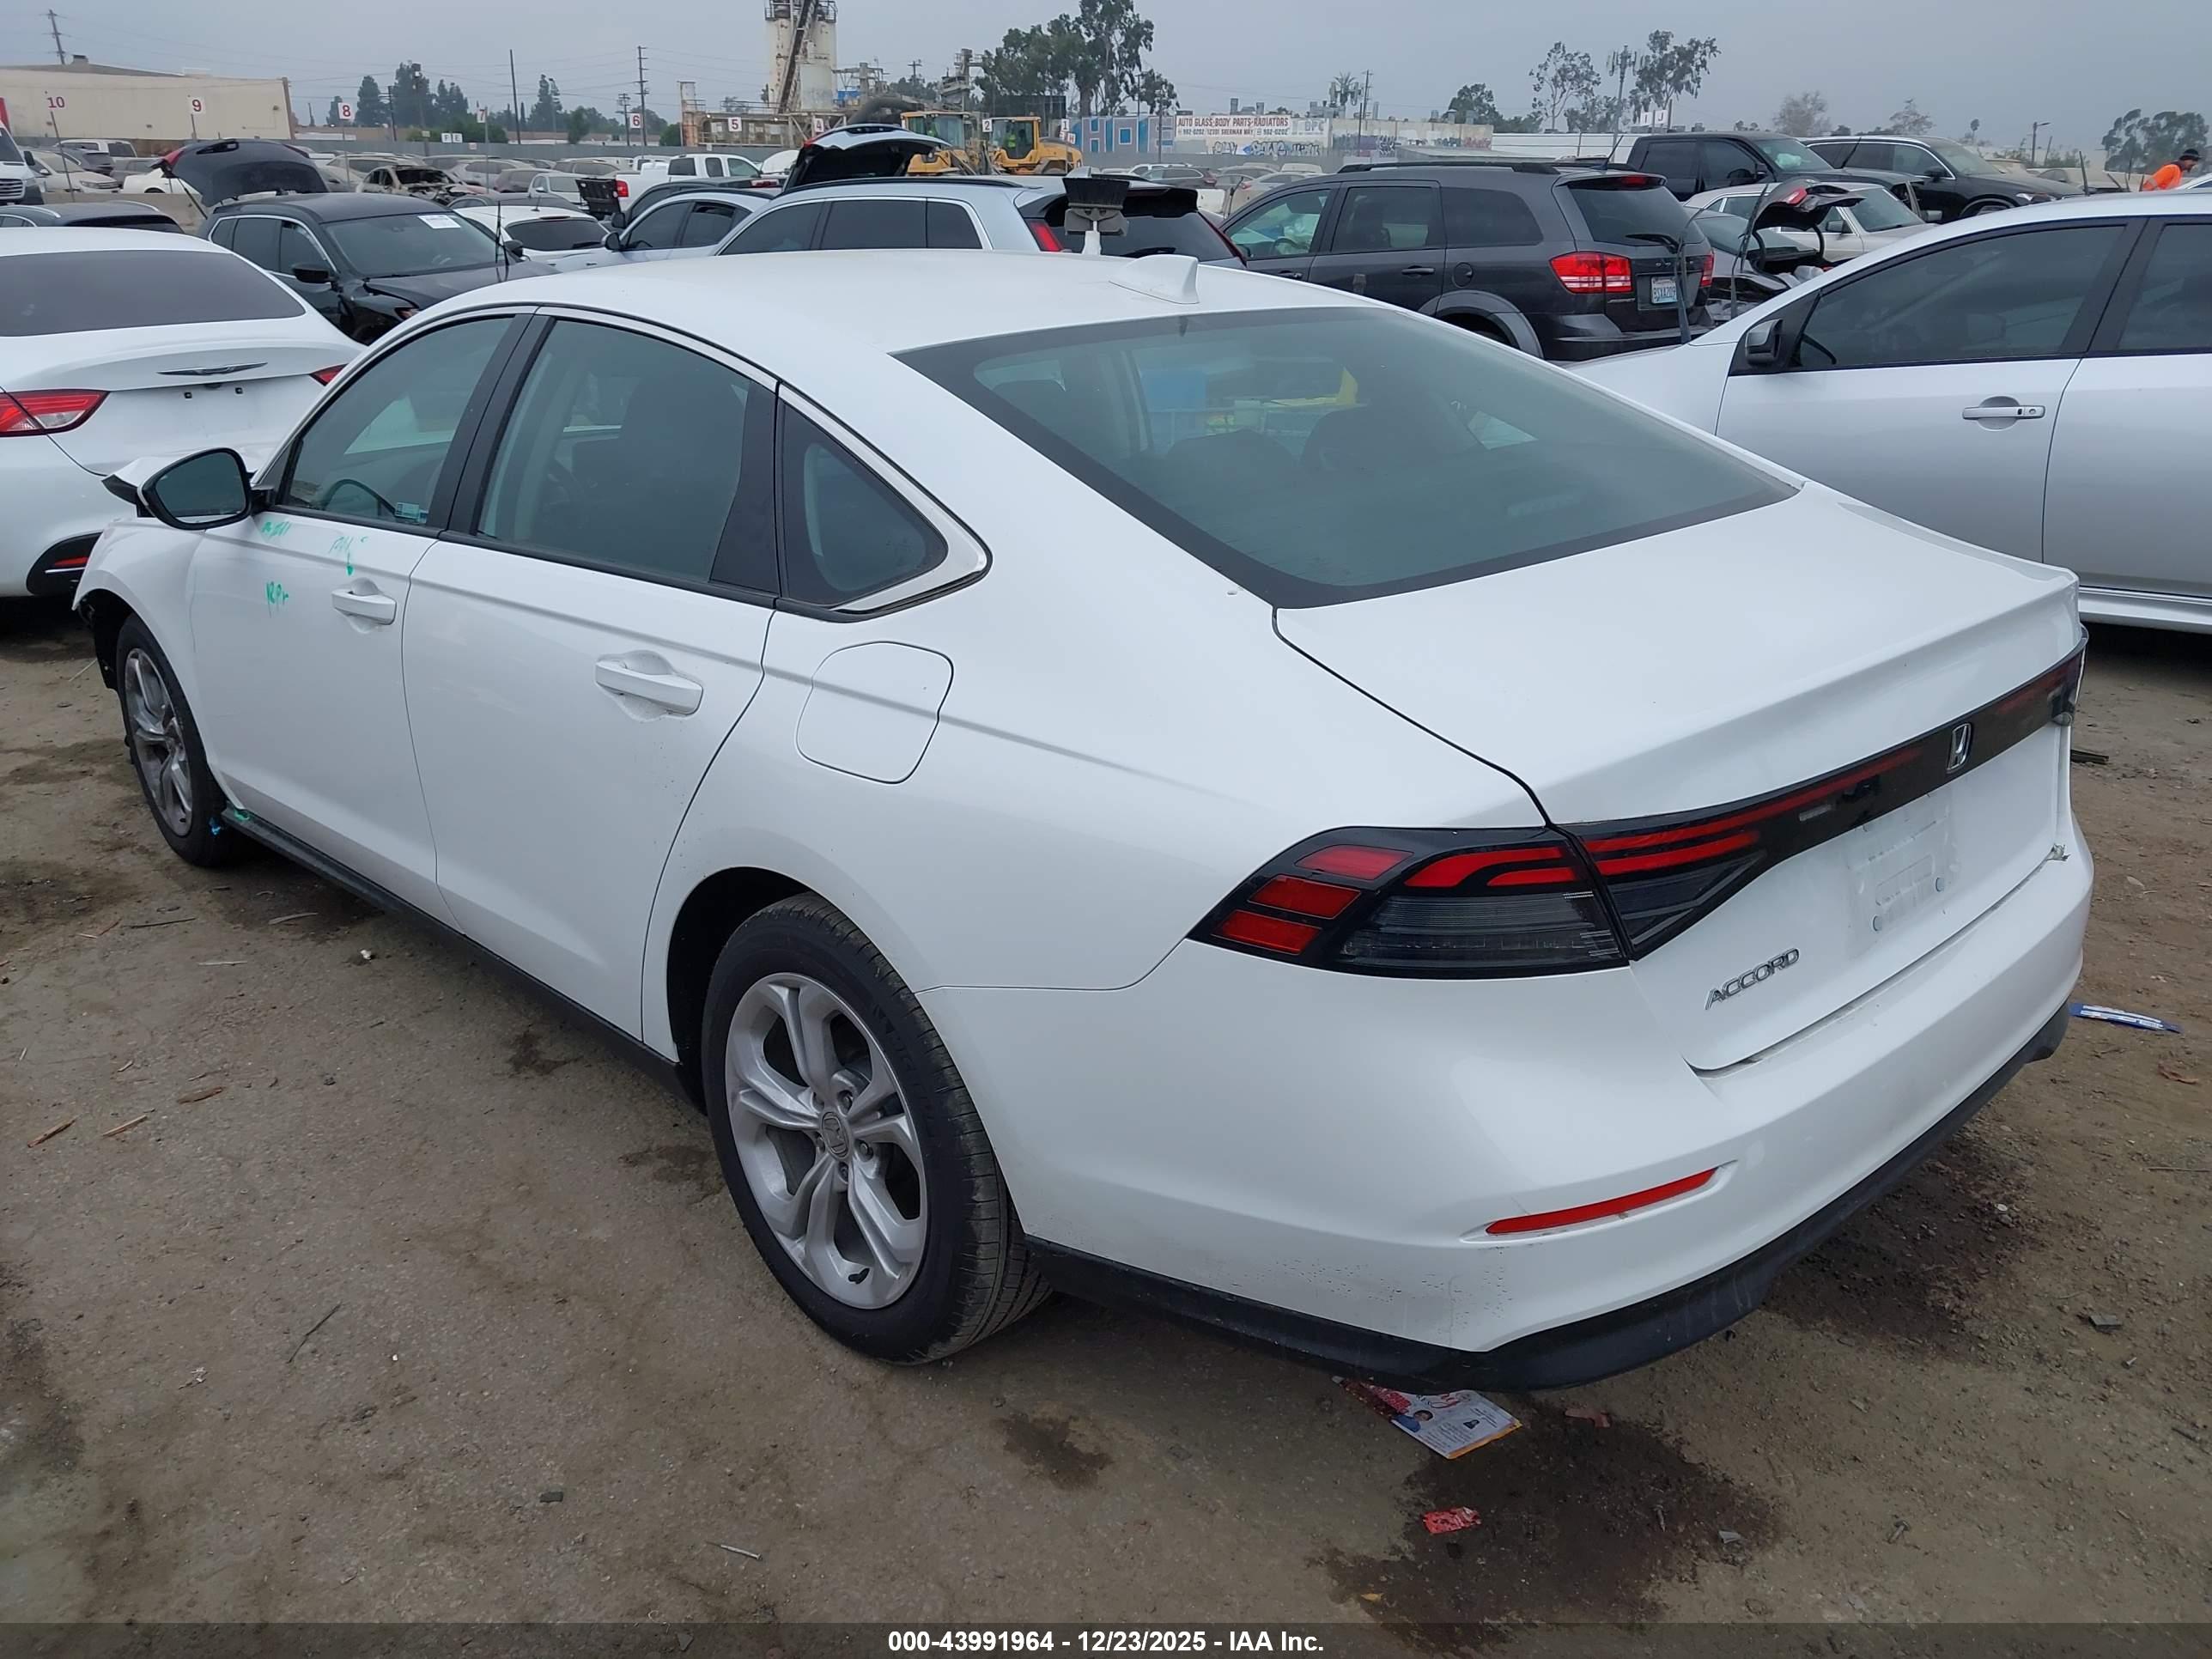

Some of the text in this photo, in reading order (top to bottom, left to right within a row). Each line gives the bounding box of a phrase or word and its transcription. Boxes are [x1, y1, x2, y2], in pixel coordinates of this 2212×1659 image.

[47, 96, 65, 108] 10
[191, 99, 202, 112] 9
[343, 106, 351, 117] 8
[479, 108, 486, 122] 7
[1658, 112, 1664, 121] J
[633, 115, 641, 126] 6
[732, 119, 738, 130] 5
[817, 119, 823, 130] 4
[985, 120, 991, 131] 2
[1064, 121, 1067, 130] 1
[1178, 117, 1193, 127] AUTO
[1705, 947, 1800, 1011] ACCORD
